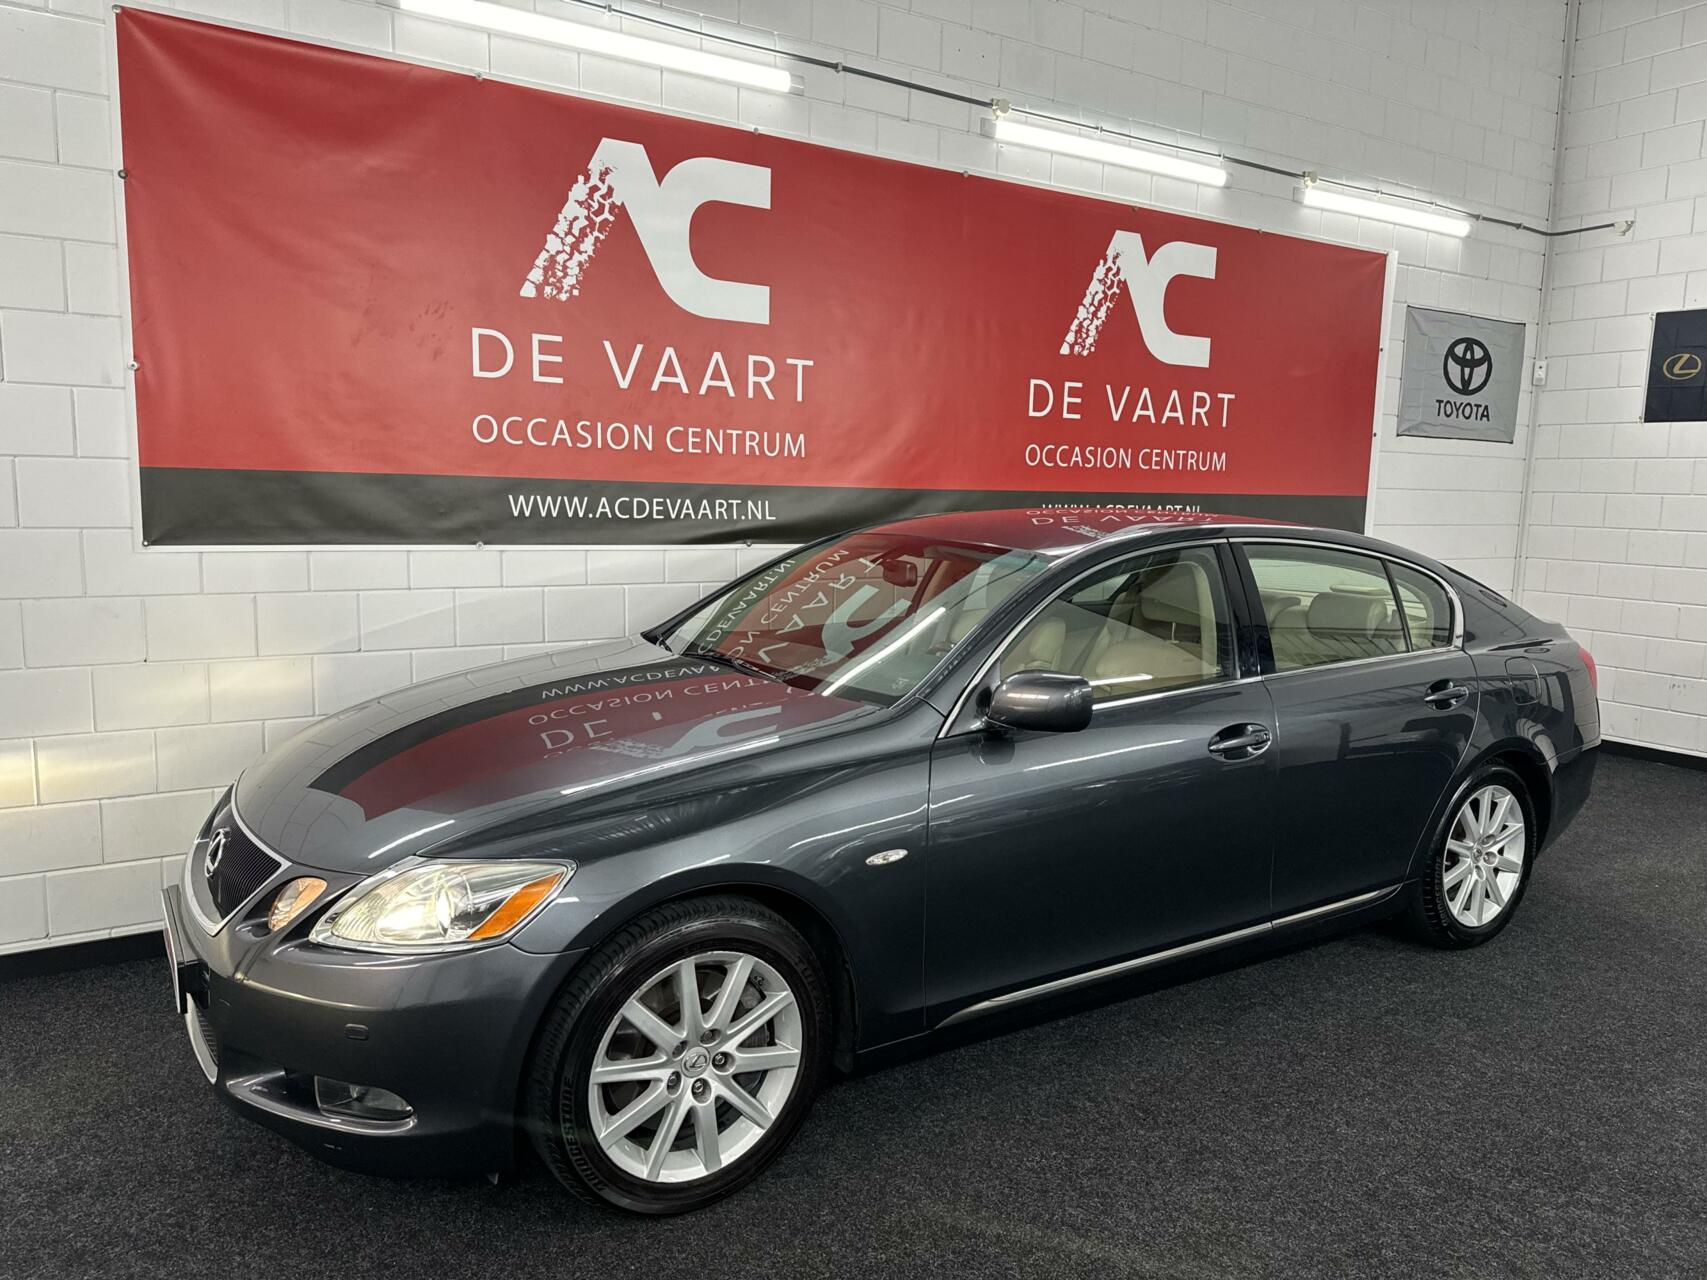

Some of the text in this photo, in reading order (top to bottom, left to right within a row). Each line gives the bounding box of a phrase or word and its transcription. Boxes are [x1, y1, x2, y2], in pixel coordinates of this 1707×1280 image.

[471, 327, 814, 402] DE VAART
[1028, 378, 1236, 428] DE VAART
[1435, 399, 1491, 422] TOYOTA
[472, 414, 806, 458] OCCASION CENTRUM
[1025, 443, 1226, 471] OCCASION CENTRUM
[508, 494, 777, 520] WWW.ACDEVAART.NL
